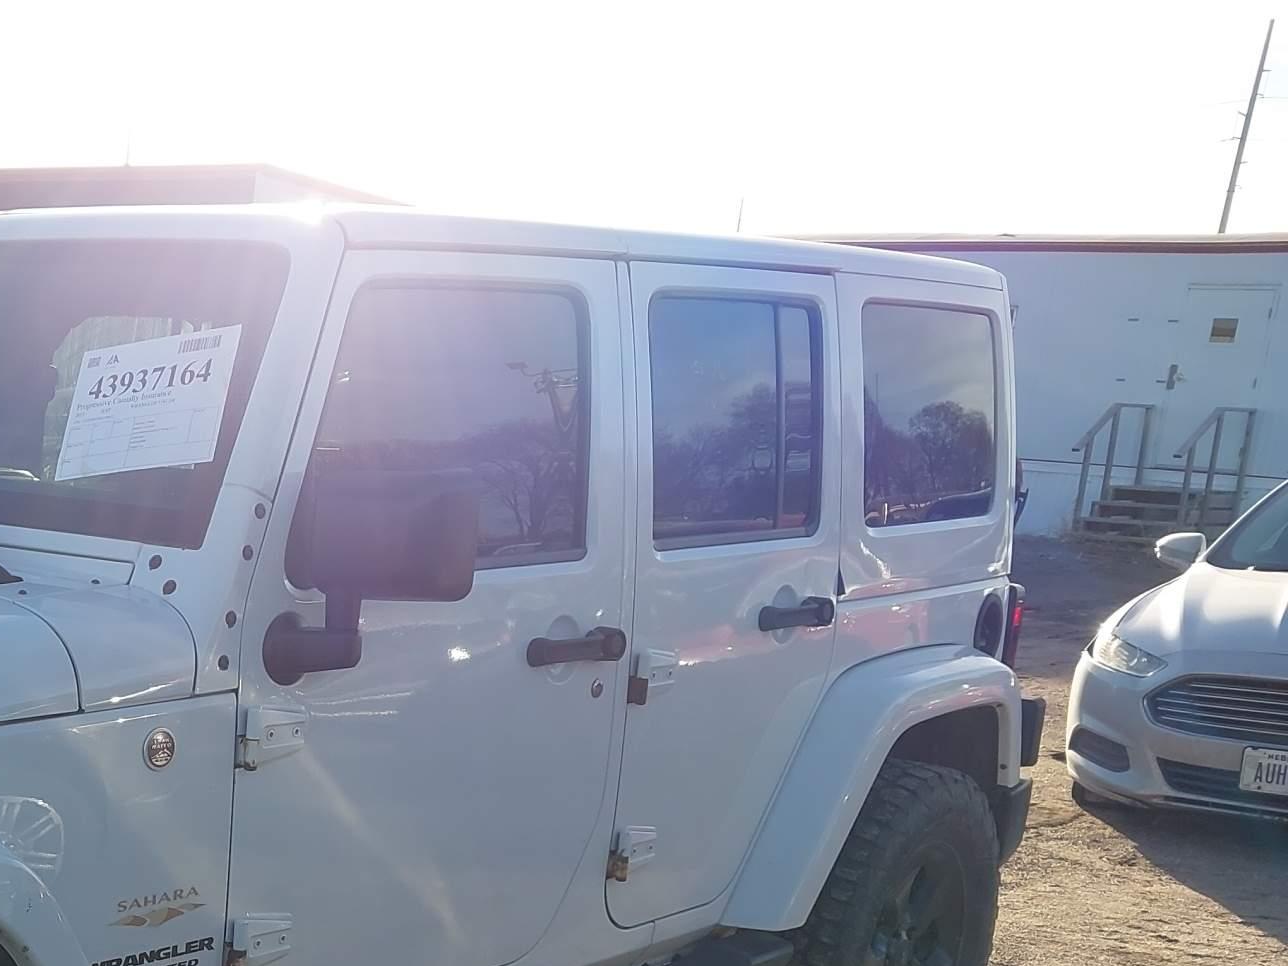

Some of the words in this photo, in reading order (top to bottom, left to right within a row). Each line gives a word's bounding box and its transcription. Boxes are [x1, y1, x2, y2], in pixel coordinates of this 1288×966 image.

[88, 358, 213, 400] 43937164
[1254, 761, 1288, 786] AUH
[117, 886, 200, 913] SAHARA
